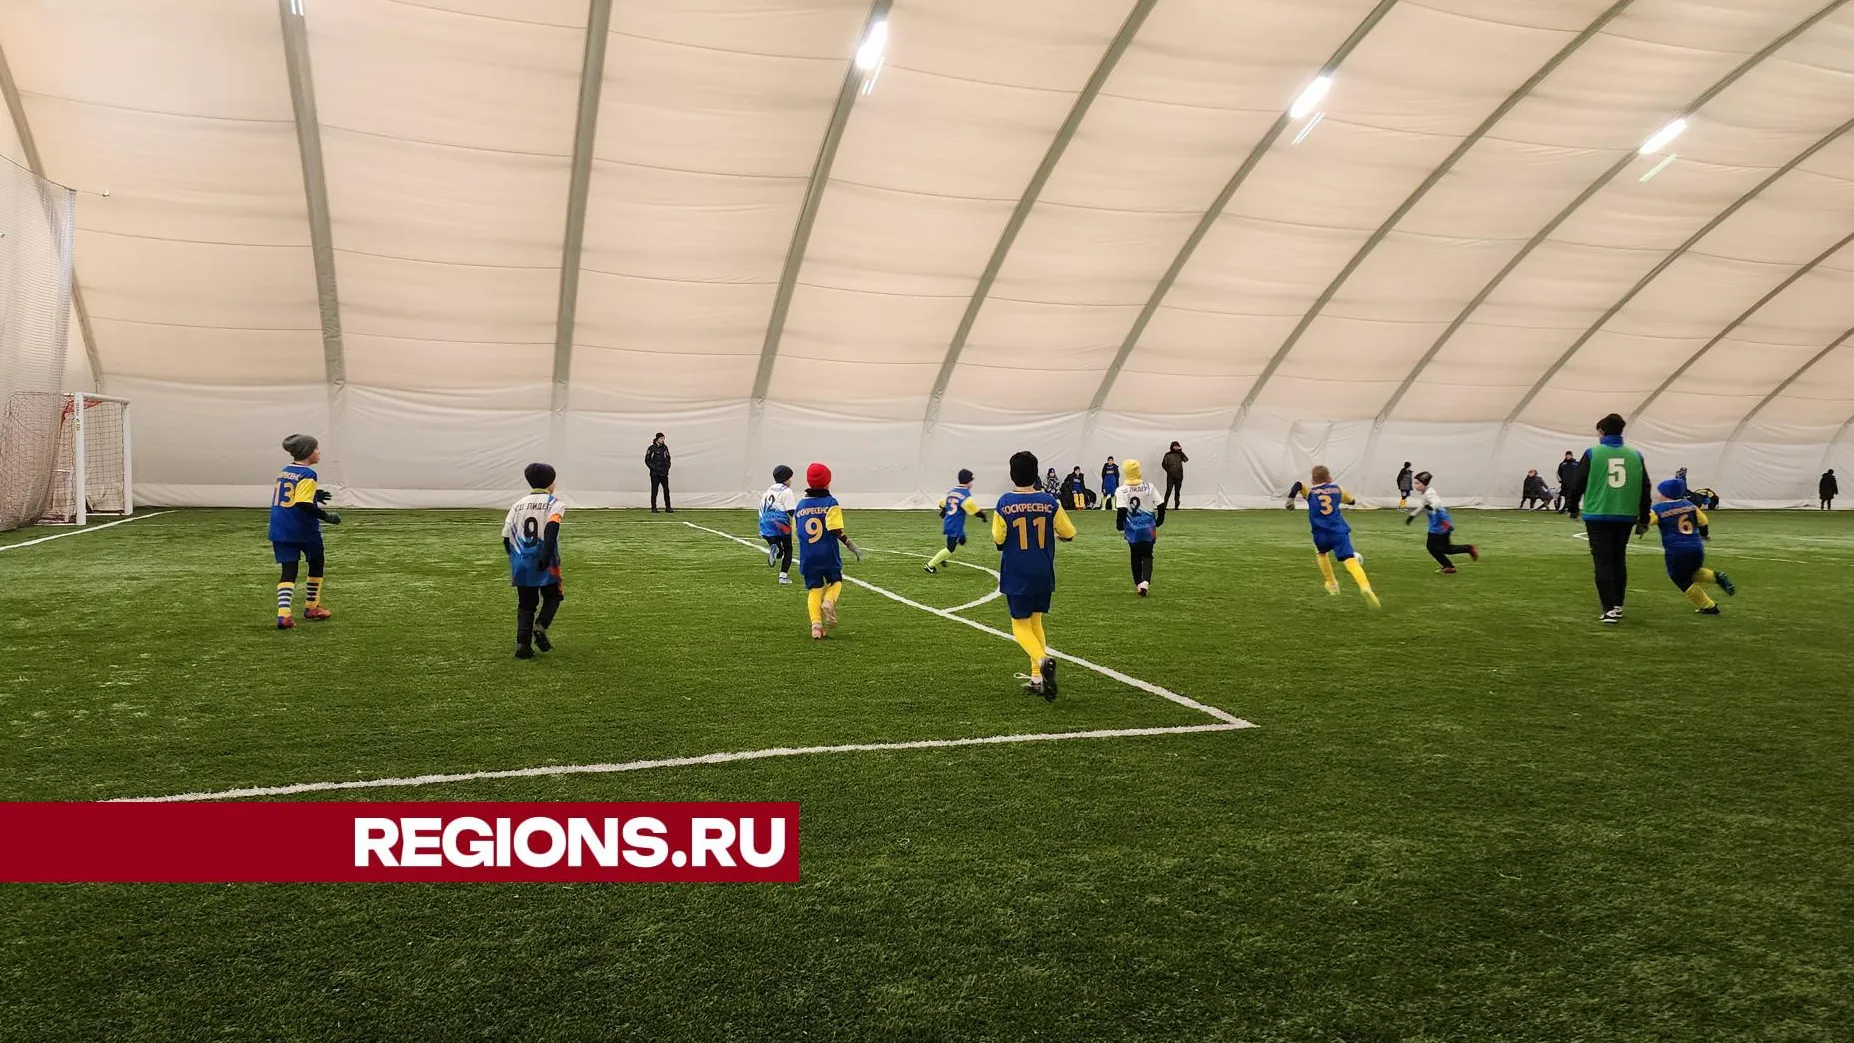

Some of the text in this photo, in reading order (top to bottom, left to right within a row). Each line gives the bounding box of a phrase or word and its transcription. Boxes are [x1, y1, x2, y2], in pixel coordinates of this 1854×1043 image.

[1608, 458, 1626, 488] 5
[273, 481, 297, 508] 13
[1317, 495, 1333, 515] 3
[524, 516, 538, 548] 9
[805, 517, 823, 544] 9
[1013, 517, 1046, 550] 11
[1677, 513, 1694, 535] 6
